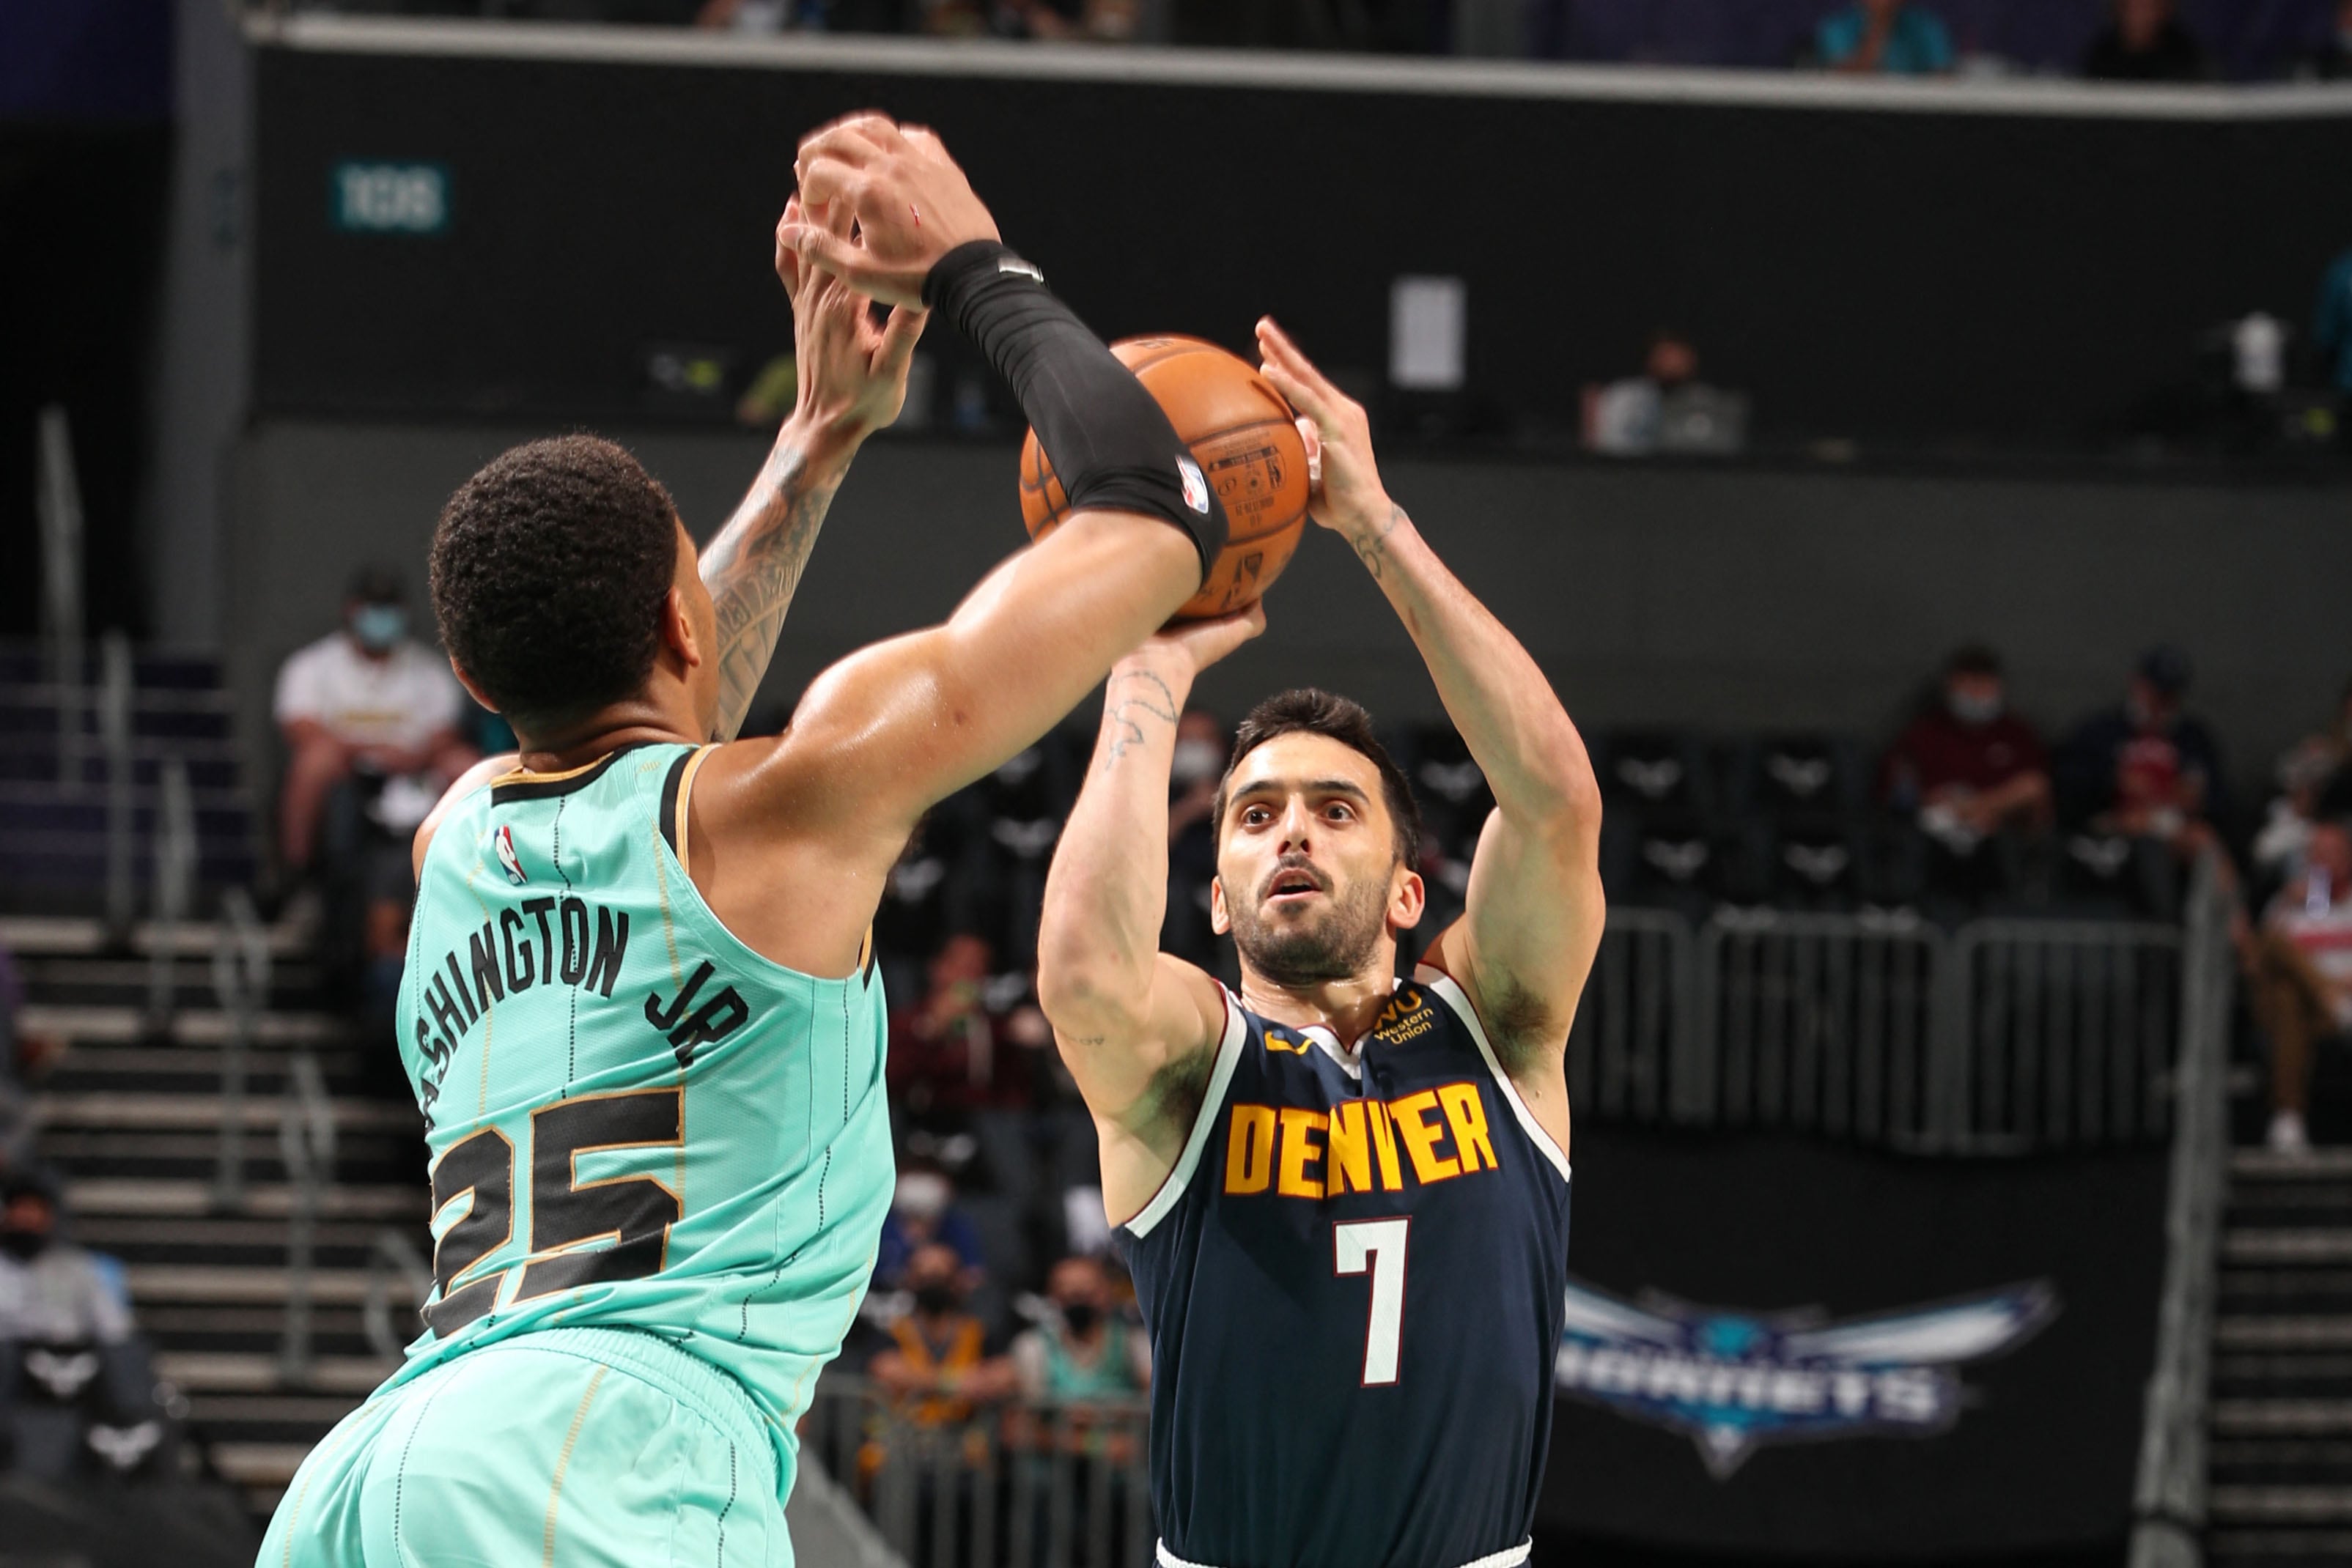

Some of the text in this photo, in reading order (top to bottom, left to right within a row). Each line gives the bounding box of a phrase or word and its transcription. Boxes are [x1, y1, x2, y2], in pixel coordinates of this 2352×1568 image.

[417, 898, 748, 1159] ASHINGTON JR
[1374, 1008, 1434, 1040] Western
[1390, 1021, 1432, 1044] Union
[419, 1086, 685, 1338] 25
[1223, 1080, 1499, 1200] DENVER
[1333, 1215, 1412, 1388] 7
